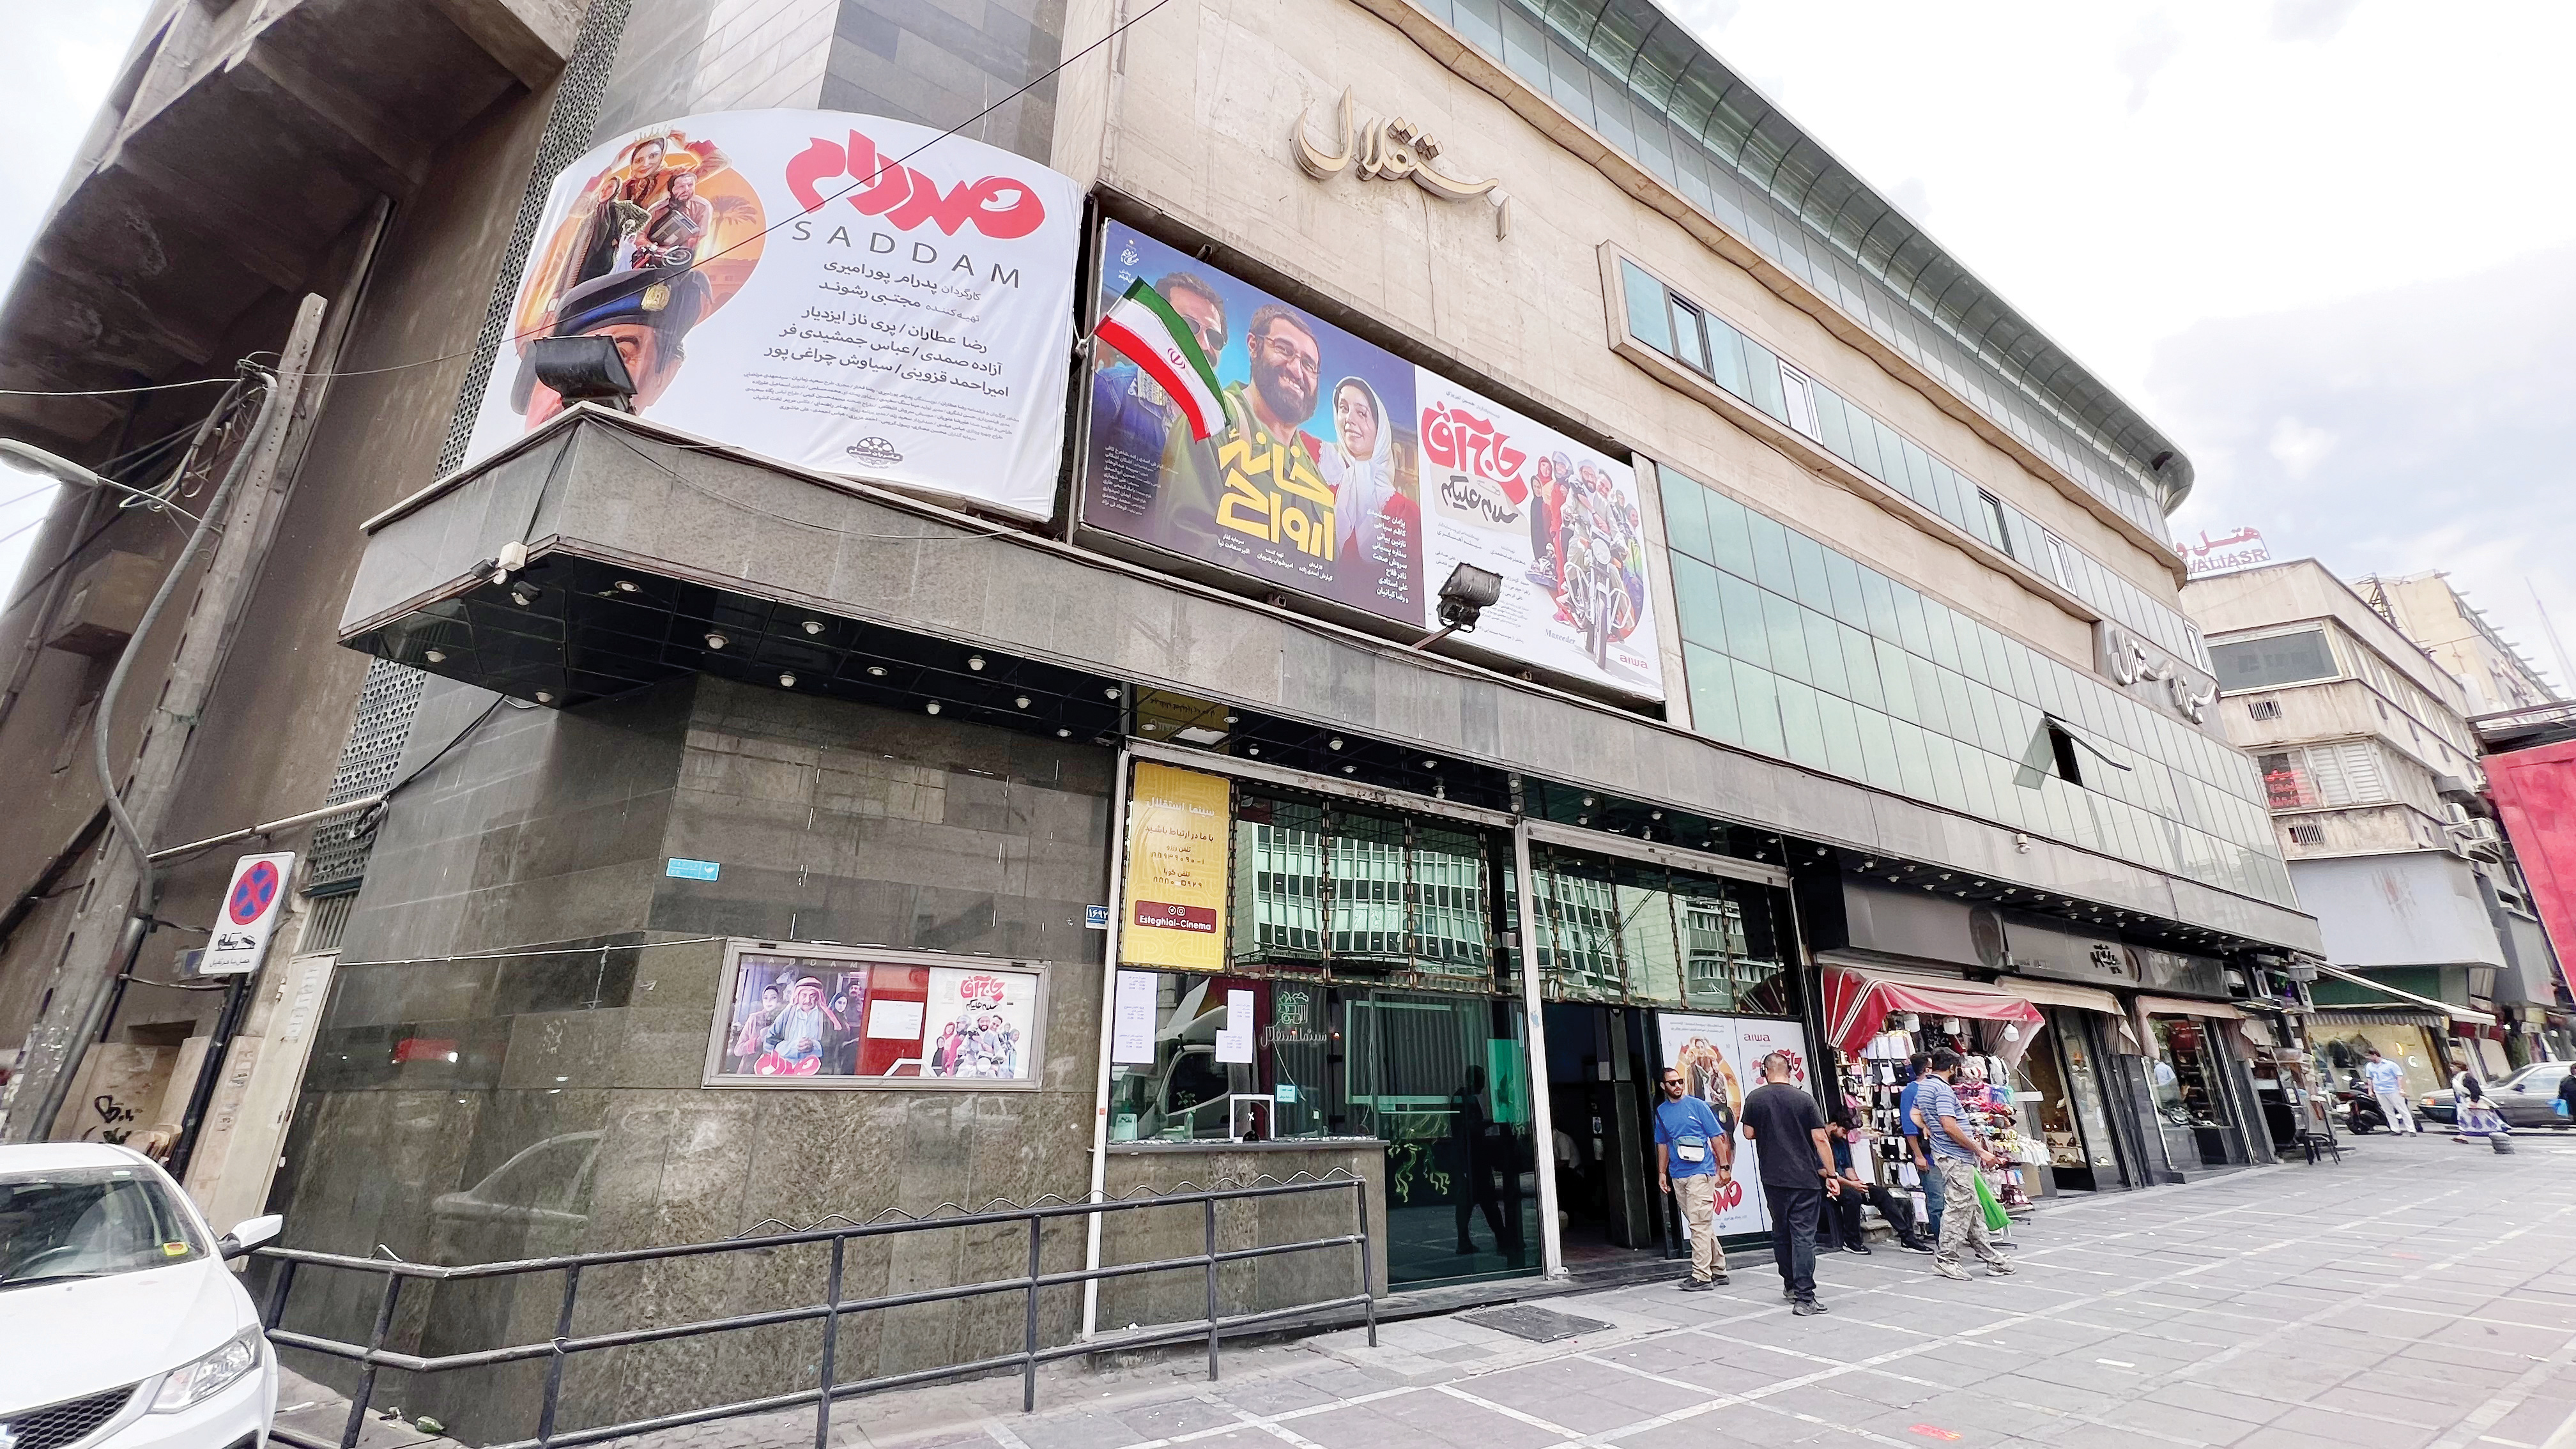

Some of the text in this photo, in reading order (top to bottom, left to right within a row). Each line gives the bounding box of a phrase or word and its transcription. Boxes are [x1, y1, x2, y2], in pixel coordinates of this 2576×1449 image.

[1290, 84, 1510, 242] استقلال
[792, 220, 1020, 289] SADDAM
[819, 279, 869, 299] رشوند
[824, 260, 981, 301] کارگردان پدرام پورامیری
[871, 292, 921, 308] مجتبی
[801, 306, 987, 354] رضا عطاران پری ناز ایزدیار
[779, 323, 1003, 376] آزاده صمدی عباس جمشیدی فر
[764, 346, 1009, 397] امیراحمد قزوینی سیاوش چراغی پور
[1441, 475, 1518, 524] سلام علیکم
[1216, 467, 1334, 562] ارواح
[2193, 526, 2260, 556] هتل
[1545, 629, 1575, 645] Maxeeder
[1620, 654, 1648, 670] aiwa
[1147, 797, 1215, 818] سینما استقلال
[1145, 825, 1167, 833] باشید
[1169, 827, 1190, 839] ارتباط
[1209, 834, 1213, 843] با
[748, 956, 857, 968] SADDAM
[1744, 1033, 1770, 1042] aiwa
